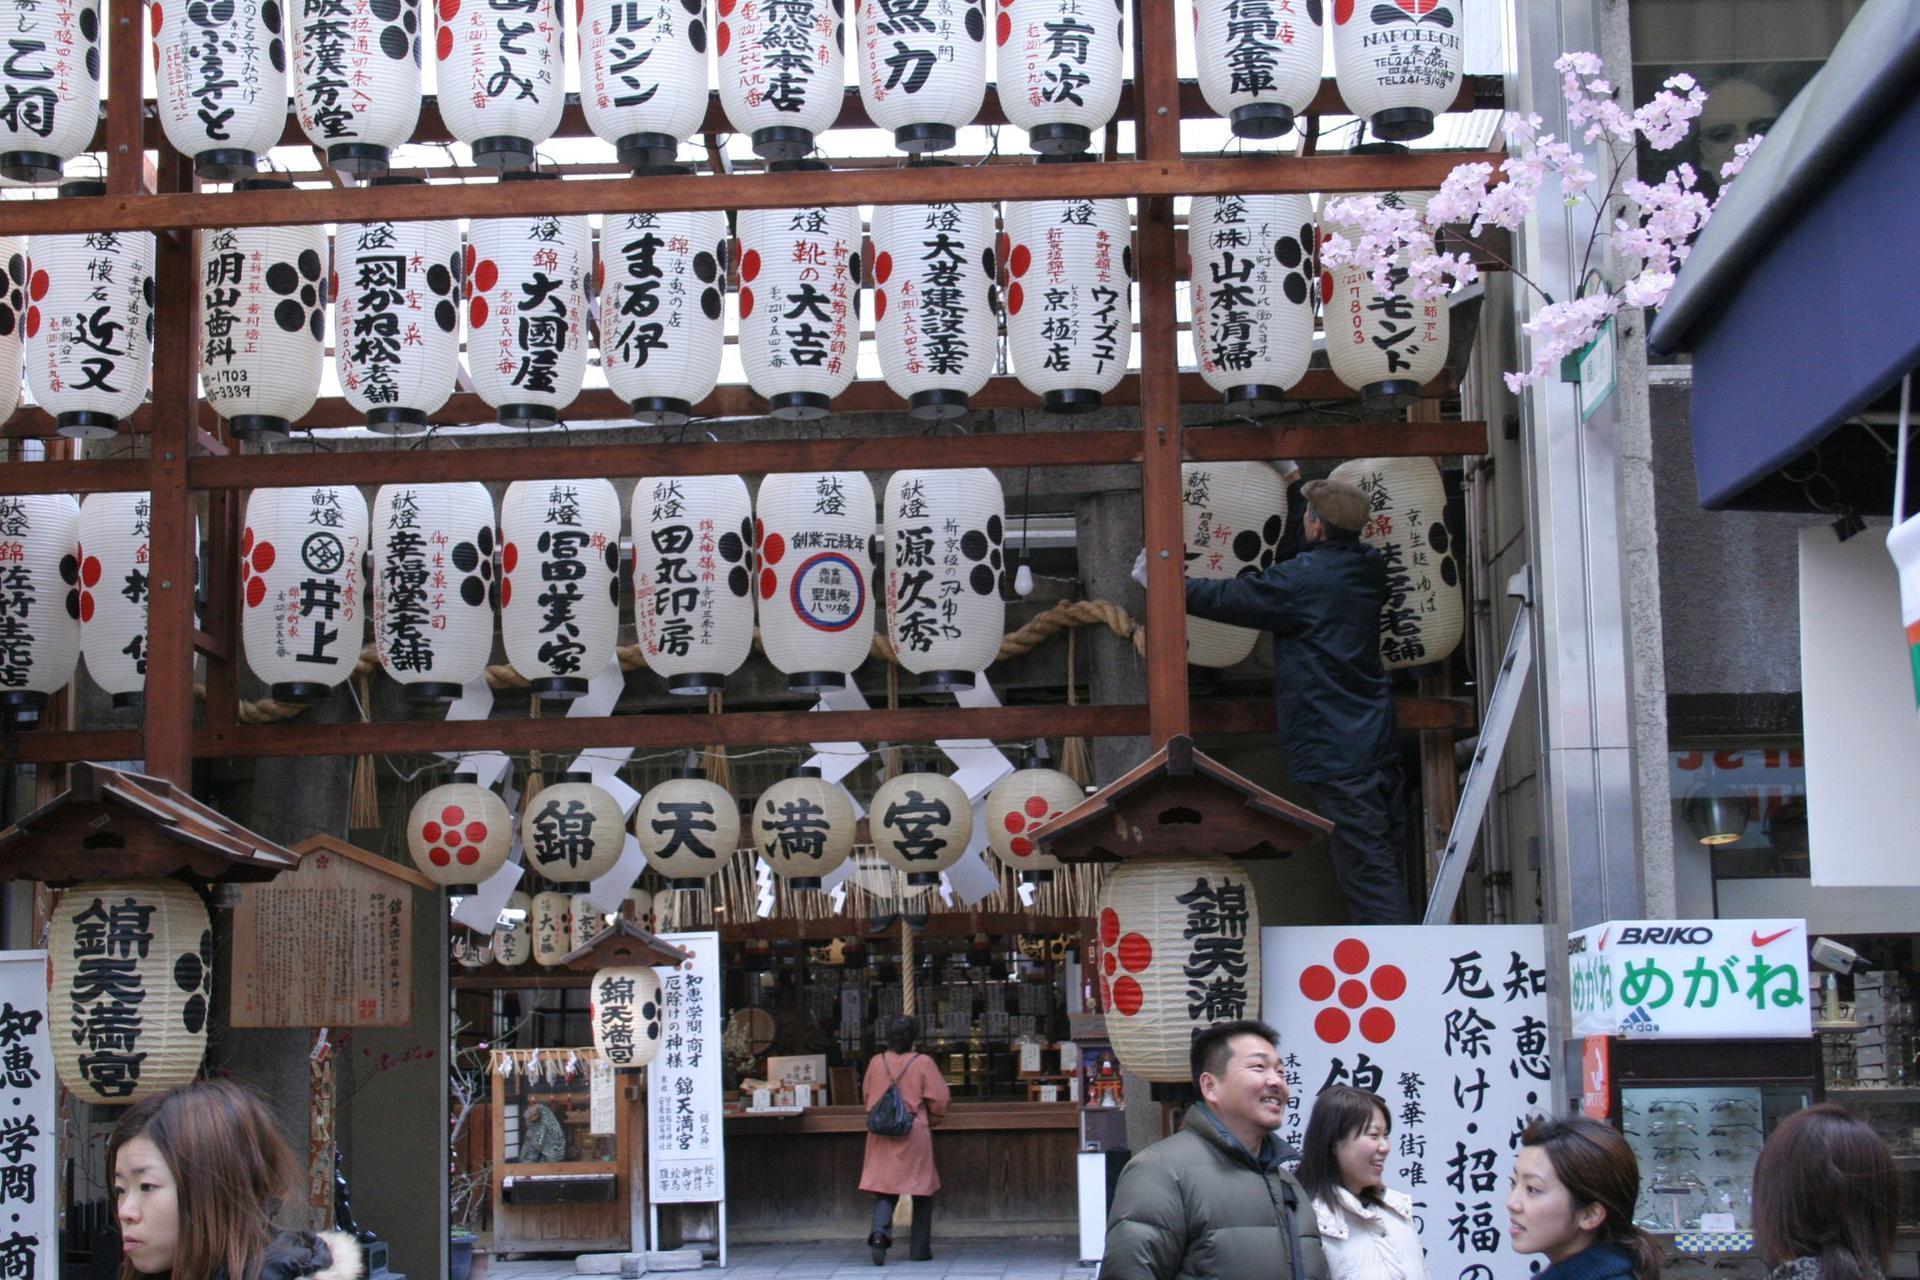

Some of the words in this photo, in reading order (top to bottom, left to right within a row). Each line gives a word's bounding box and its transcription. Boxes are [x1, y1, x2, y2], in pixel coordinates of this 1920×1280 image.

[608, 2, 659, 107] ルシン
[1043, 18, 1096, 107] 有次
[1222, 0, 1282, 97] 信用金庫
[1363, 28, 1460, 50] NAPOLEON
[190, 30, 239, 140] ふるさと
[533, 249, 559, 273] 錦
[792, 240, 827, 281] 靴の
[1209, 227, 1251, 250] (株)
[205, 252, 246, 365] 明山歯科
[511, 272, 568, 394] 大國屋
[784, 284, 832, 366] 大吉
[921, 234, 968, 375] 大岩建設工業
[1041, 287, 1073, 373] 京極店
[1210, 252, 1258, 372] 山本清掃
[1343, 264, 1366, 345] (221)7803
[69, 306, 125, 393] 近又
[295, 578, 342, 665] 井上
[386, 531, 434, 674] 幸福堂老舗
[428, 530, 449, 631] 御生菓子司
[652, 525, 700, 657] 田丸印房
[532, 800, 597, 869] 錦
[651, 801, 717, 859] 天
[761, 797, 830, 860] 満
[883, 790, 951, 861] 宮
[1175, 877, 1249, 1034] 錦天満
[1616, 926, 1713, 945] BRIKO
[70, 898, 156, 1097] 錦天満宮
[599, 976, 636, 1064] 錦天満宮
[665, 974, 683, 1069] 厄除けの神様
[1620, 954, 1804, 1010] めがね
[674, 1076, 695, 1150] 錦天満宮
